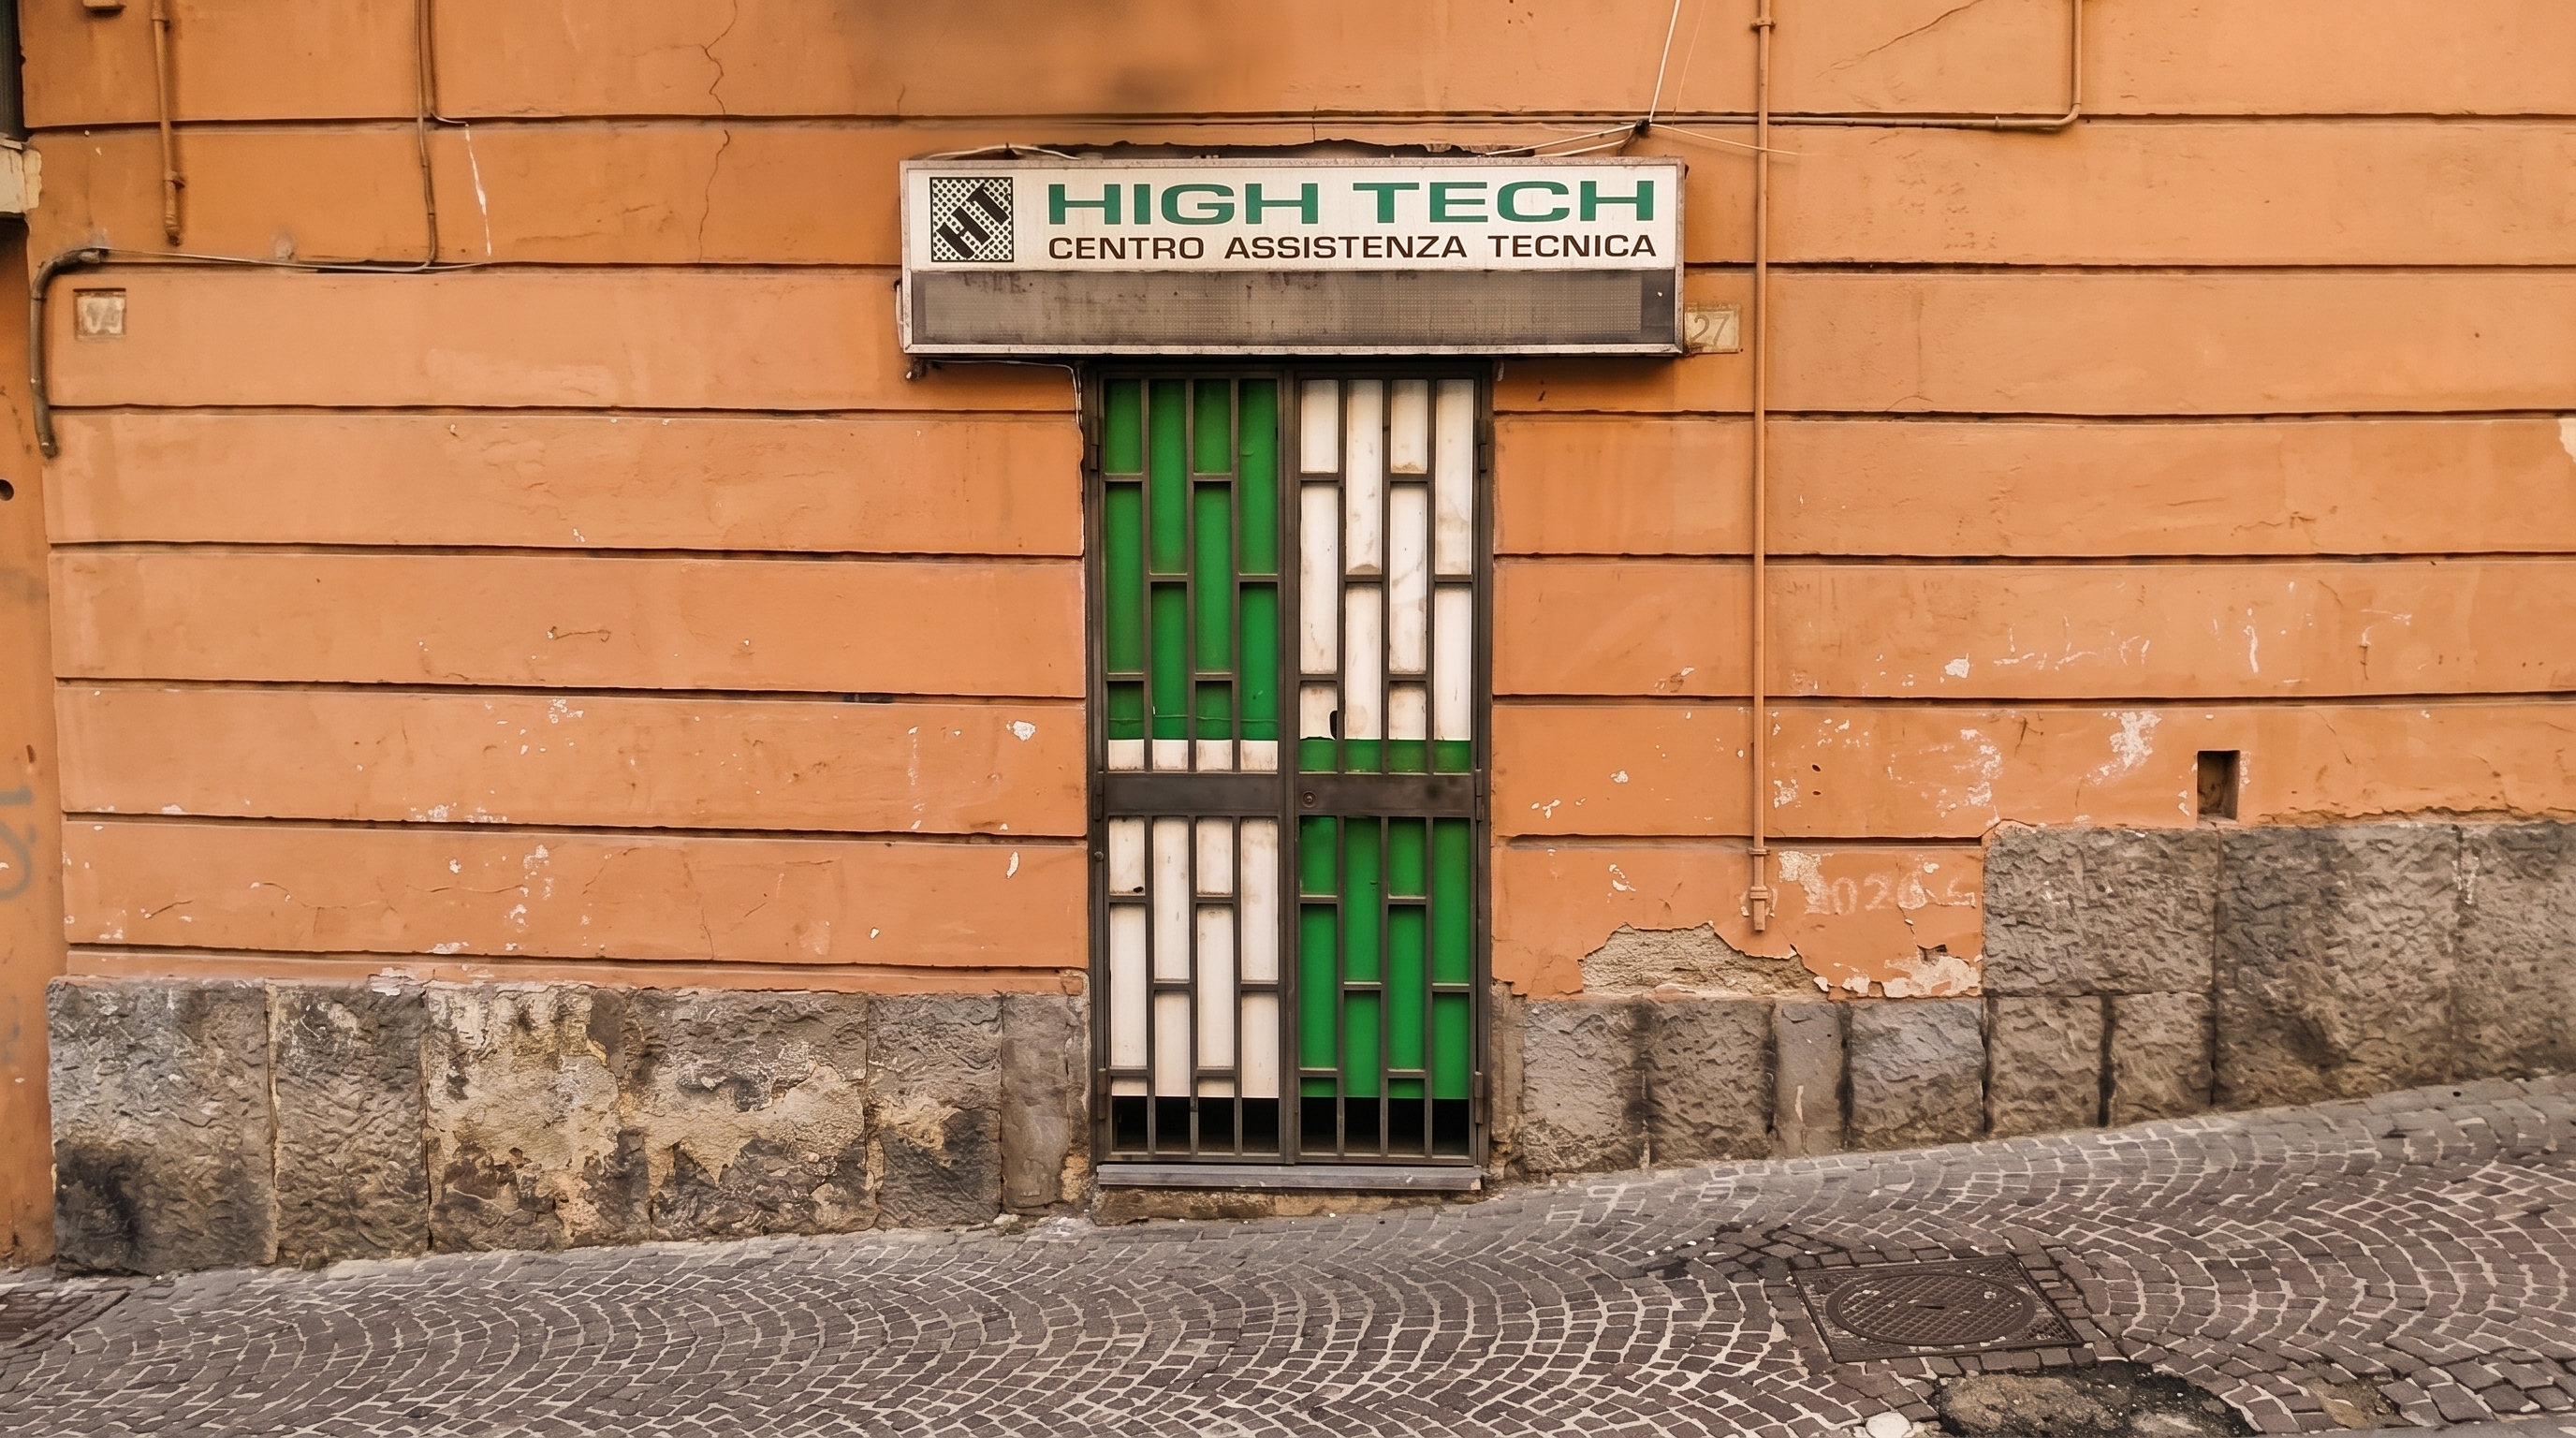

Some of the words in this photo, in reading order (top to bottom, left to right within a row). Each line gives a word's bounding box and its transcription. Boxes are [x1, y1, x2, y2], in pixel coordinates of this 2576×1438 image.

[1047, 183, 1319, 226] HIGH
[1353, 180, 1655, 224] TECH
[1048, 236, 1205, 260] CENTRO
[1223, 235, 1468, 259] ASSISTENZA
[1487, 233, 1657, 258] TECNICA
[1689, 314, 1731, 346] 27
